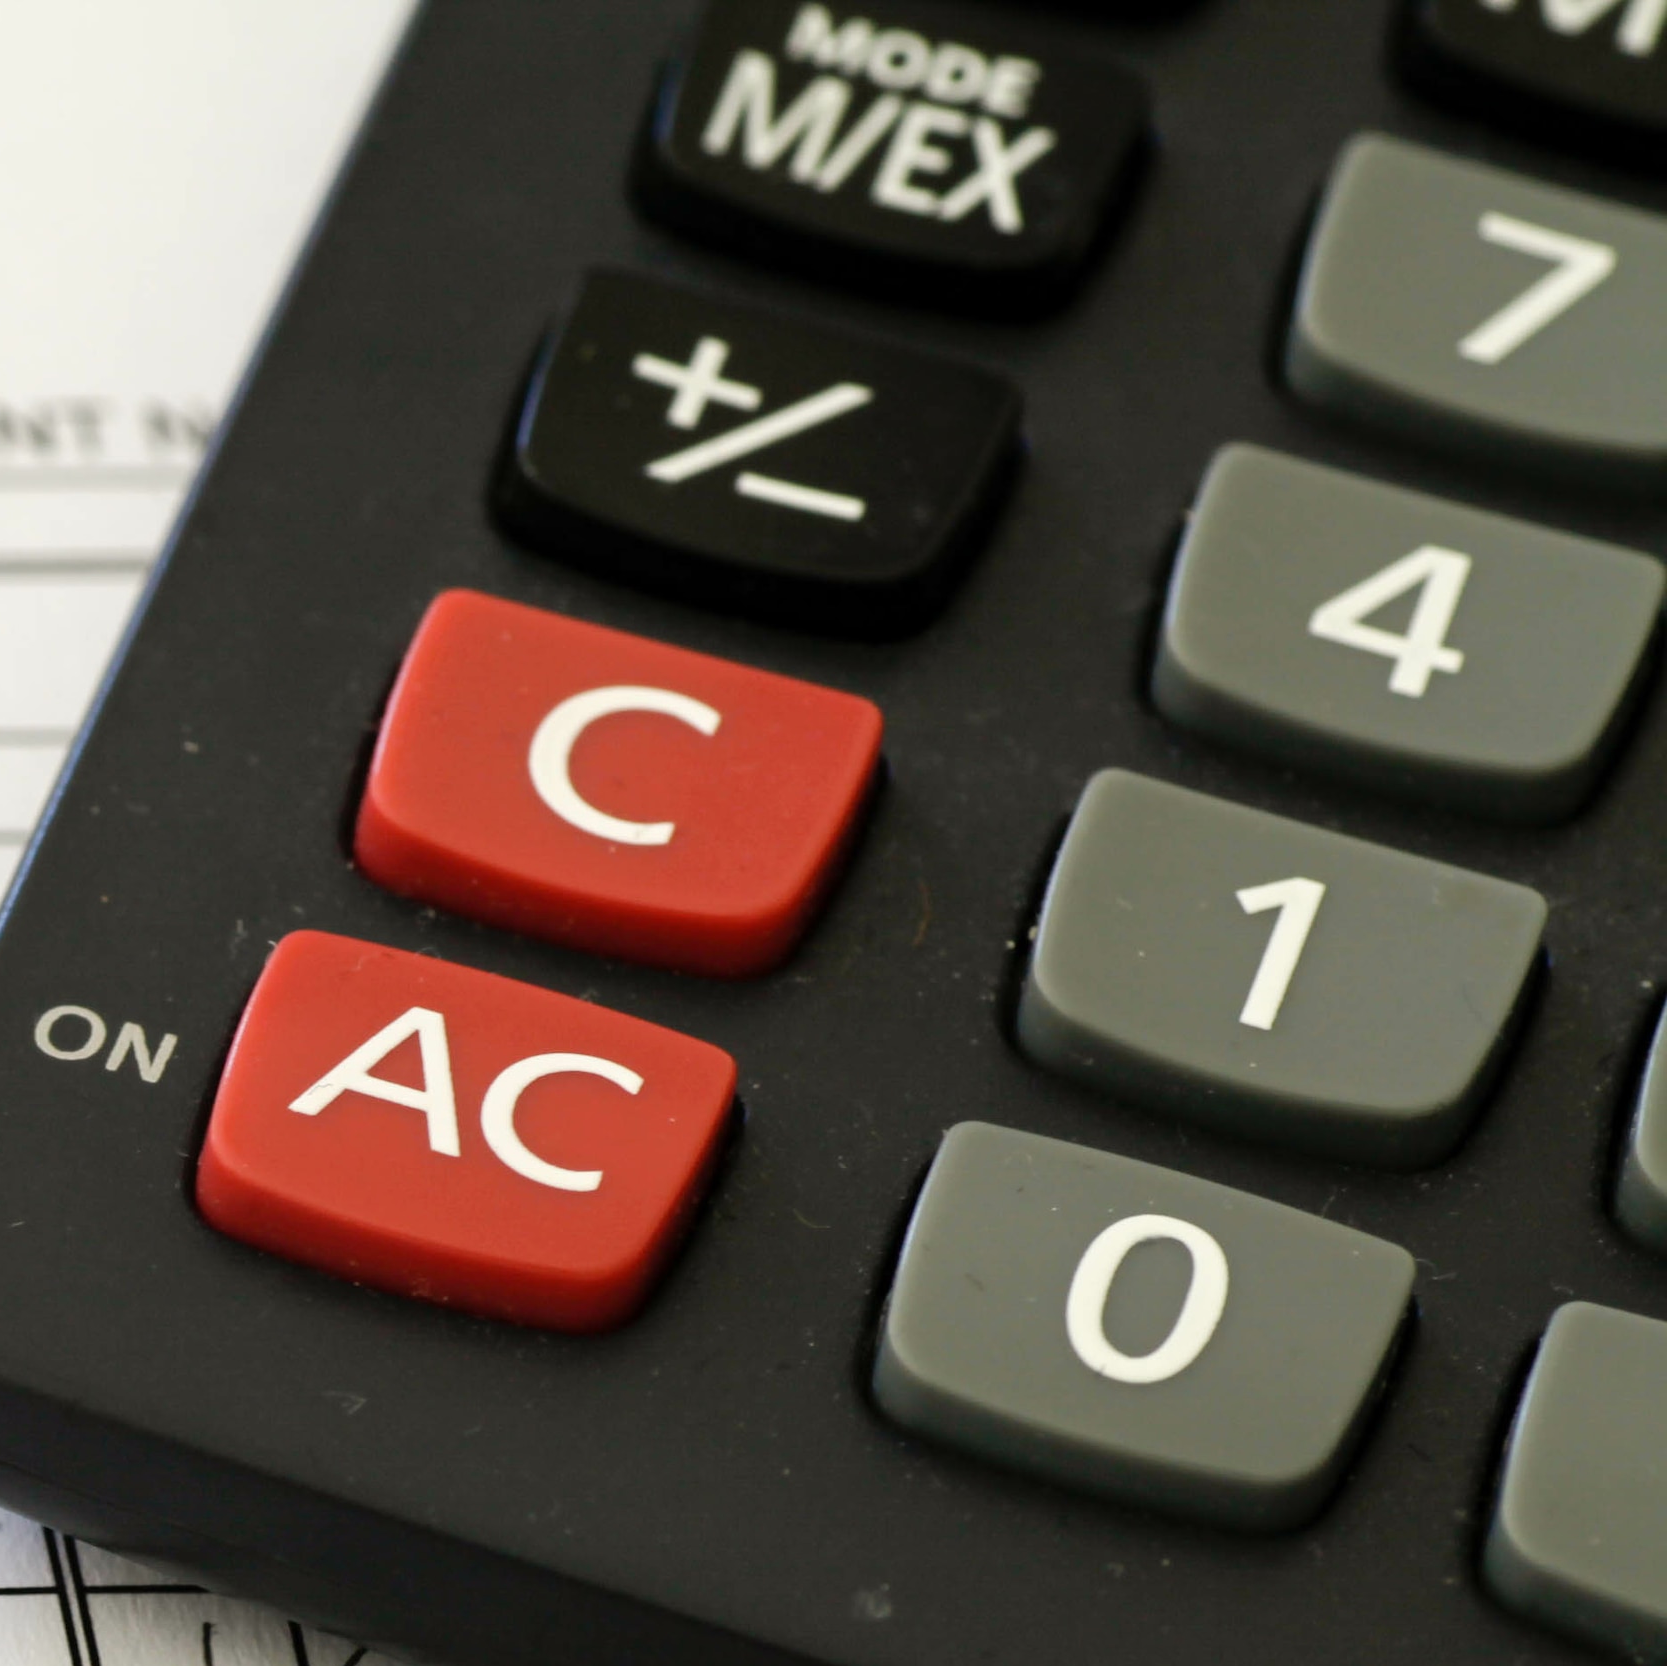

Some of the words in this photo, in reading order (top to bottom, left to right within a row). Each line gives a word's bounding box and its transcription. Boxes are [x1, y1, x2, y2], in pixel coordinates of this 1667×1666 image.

[786, 4, 1040, 117] MODE
[701, 50, 1056, 232] M/EX
[1459, 212, 1618, 364] 7
[1308, 542, 1475, 697] 4
[526, 684, 721, 846] C
[1235, 875, 1327, 1031] 1
[32, 1004, 177, 1084] ON
[287, 1007, 644, 1193] AC
[1064, 1213, 1229, 1385] 0
